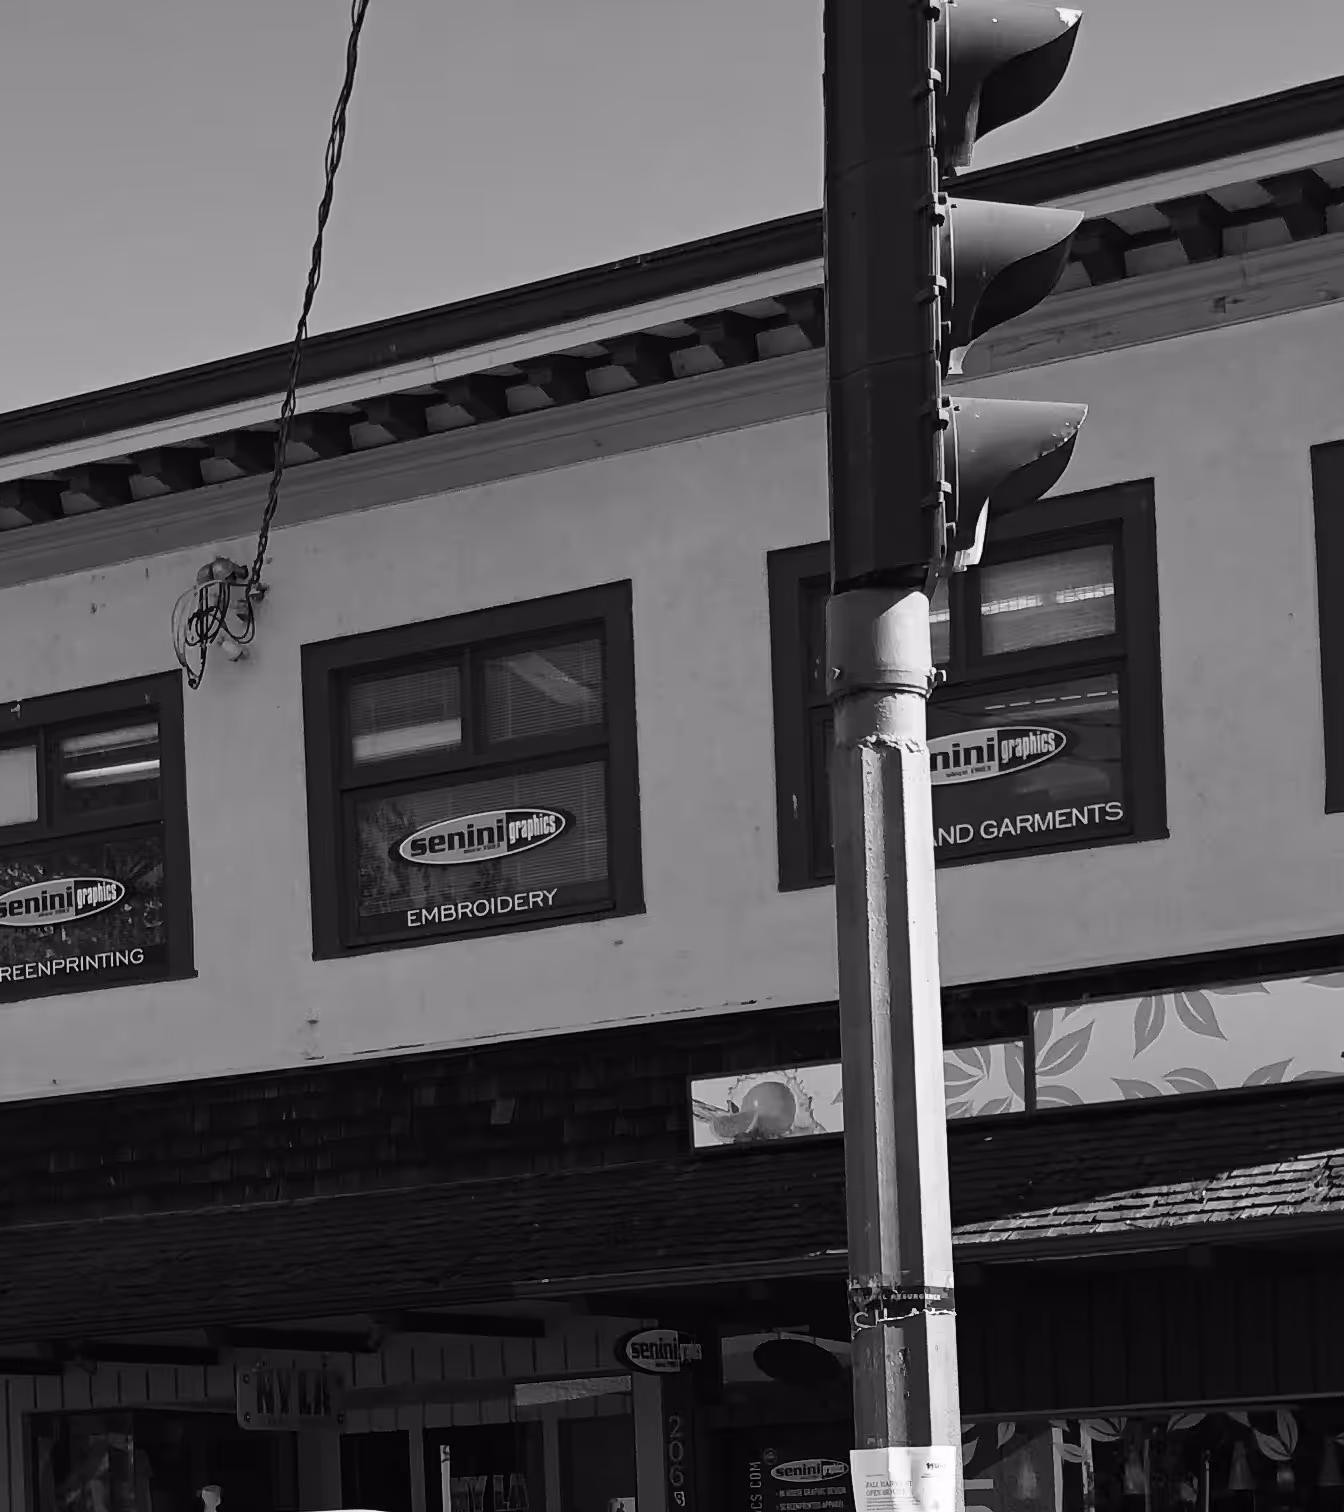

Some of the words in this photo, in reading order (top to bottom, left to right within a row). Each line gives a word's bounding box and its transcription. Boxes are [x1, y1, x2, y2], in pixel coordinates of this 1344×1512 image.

[930, 737, 995, 772] nini
[1001, 731, 1056, 764] graphics
[411, 819, 505, 857] senini
[509, 813, 556, 844] graphics
[934, 823, 974, 847] ND
[980, 801, 1124, 839] GARMENTS
[77, 882, 117, 909] graphics
[407, 888, 558, 927] EMBROIDERY
[631, 1338, 678, 1362] senini
[776, 1462, 821, 1478] senini
